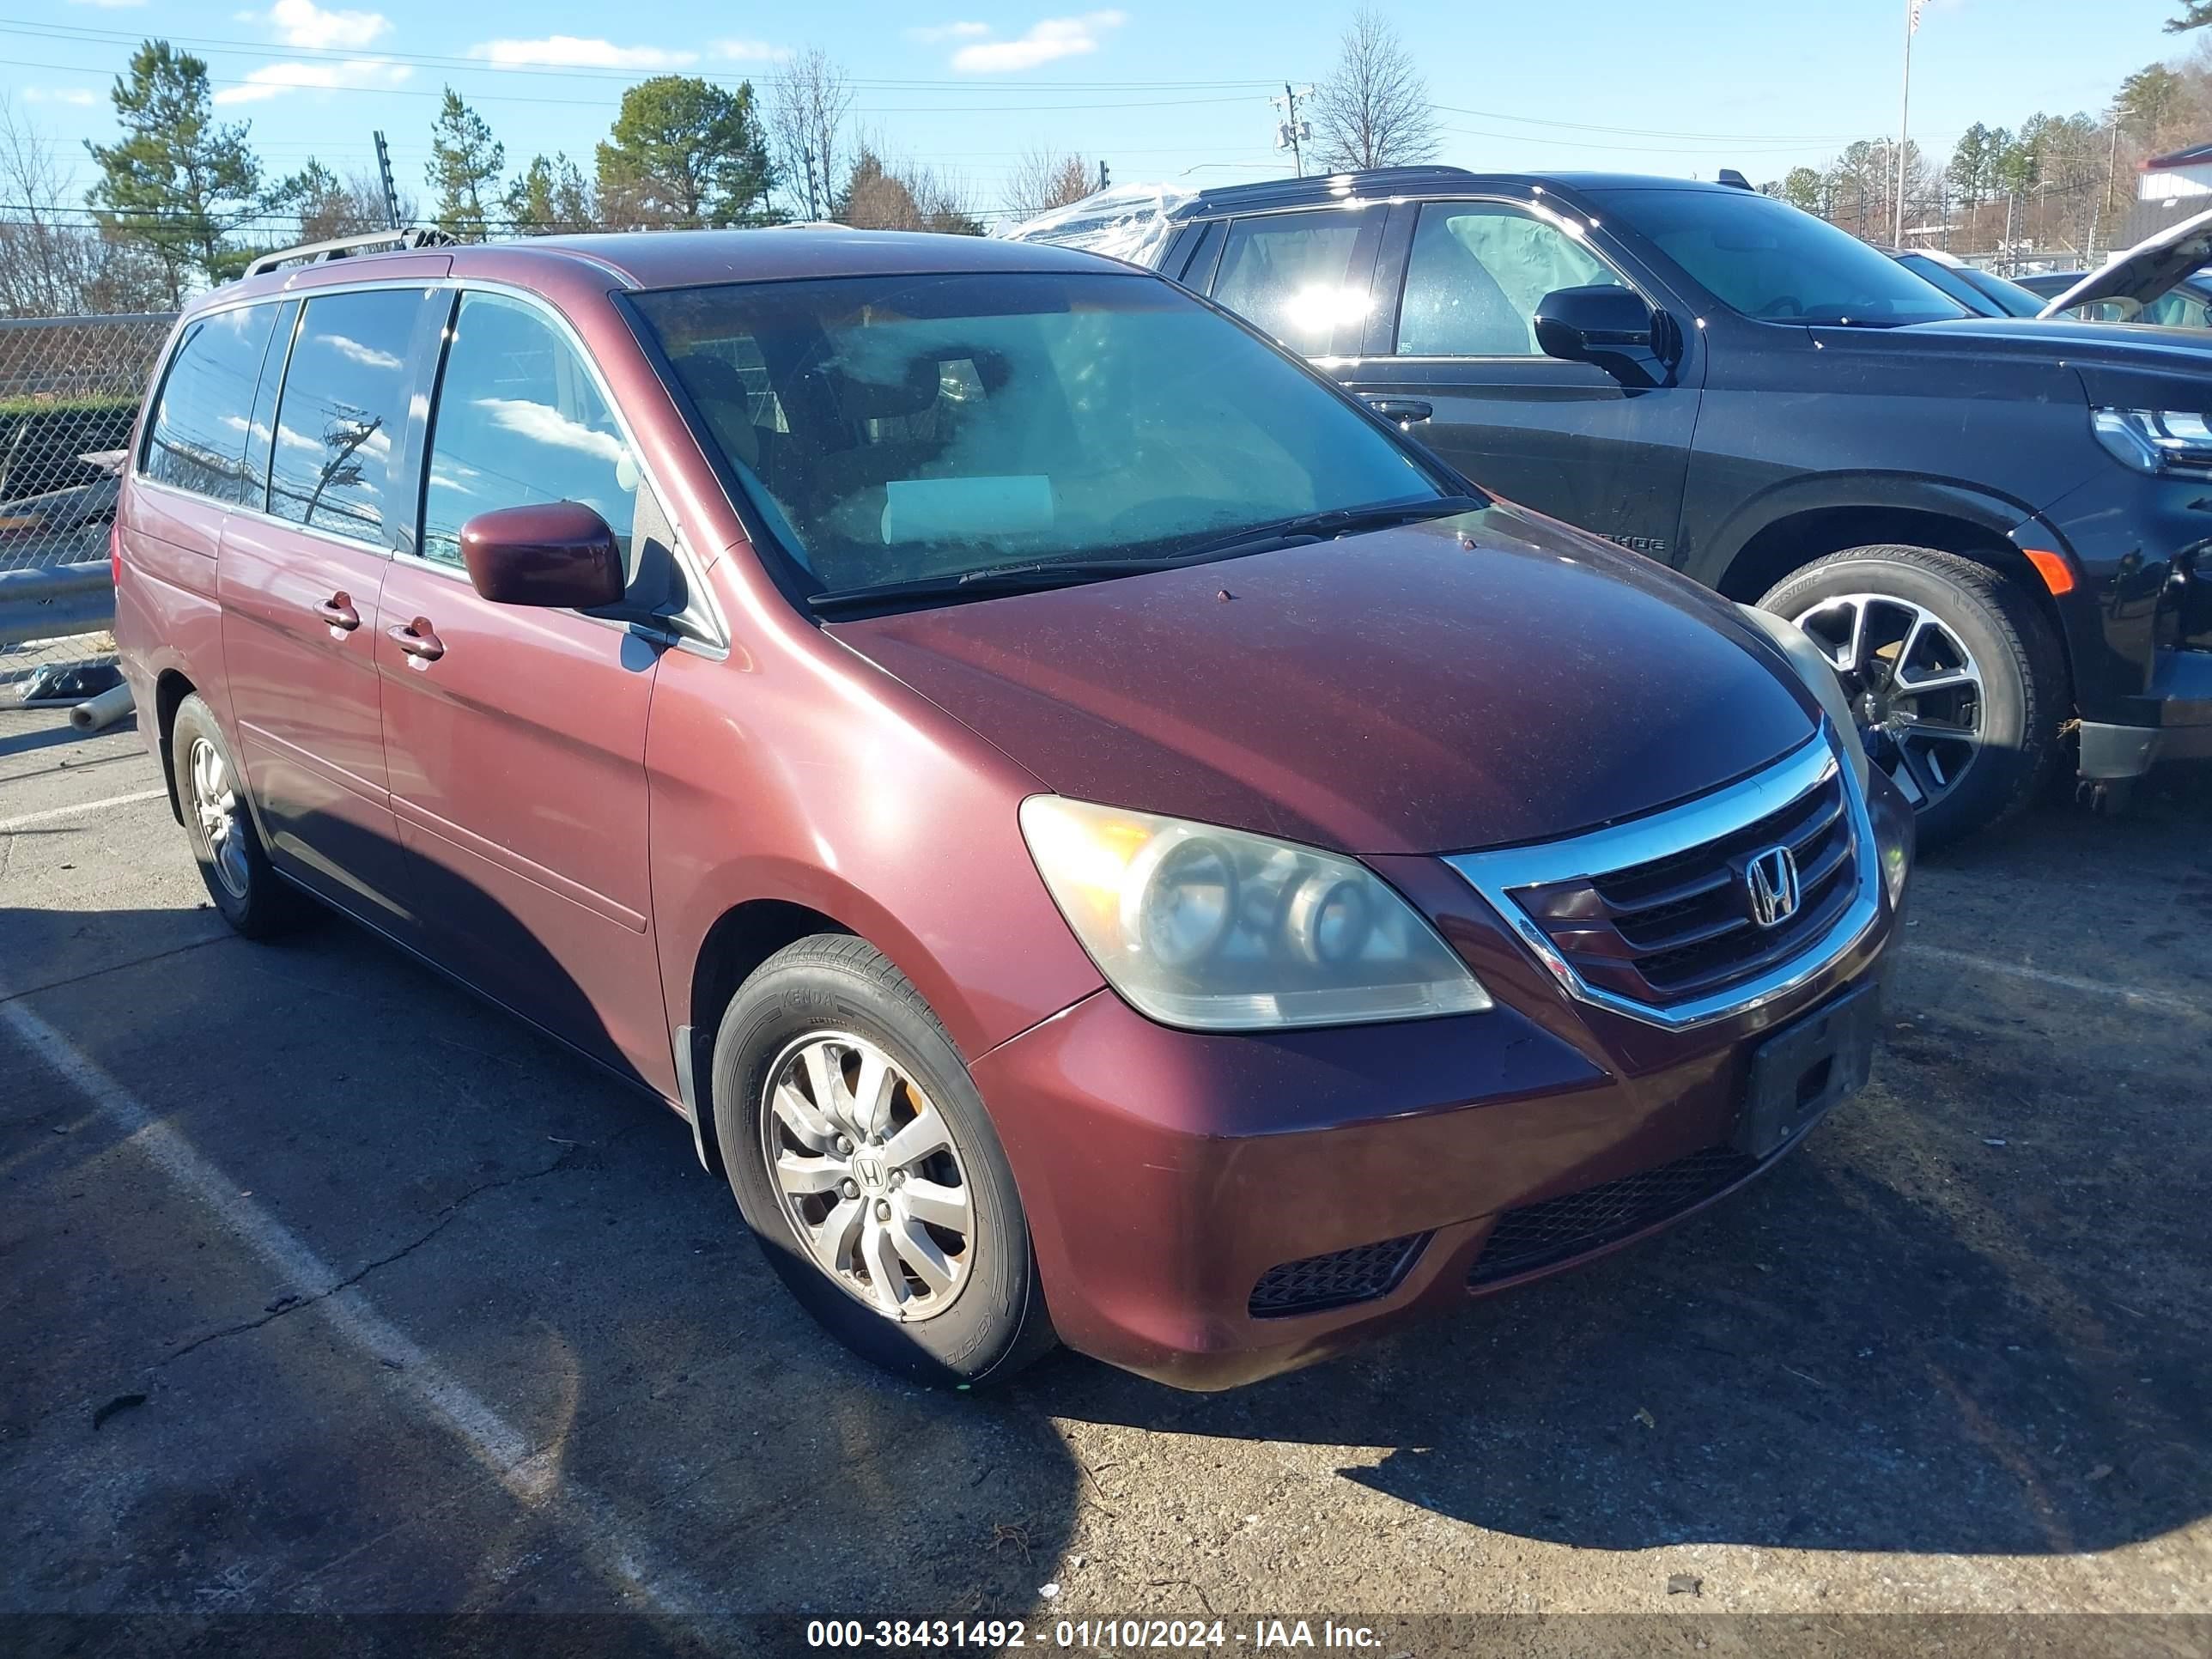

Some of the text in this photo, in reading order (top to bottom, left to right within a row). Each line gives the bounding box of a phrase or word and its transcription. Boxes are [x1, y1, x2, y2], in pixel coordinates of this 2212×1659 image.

[1598, 534, 1666, 550] HOE
[1769, 576, 1819, 612] GESTONE
[781, 988, 833, 1008] KENDA
